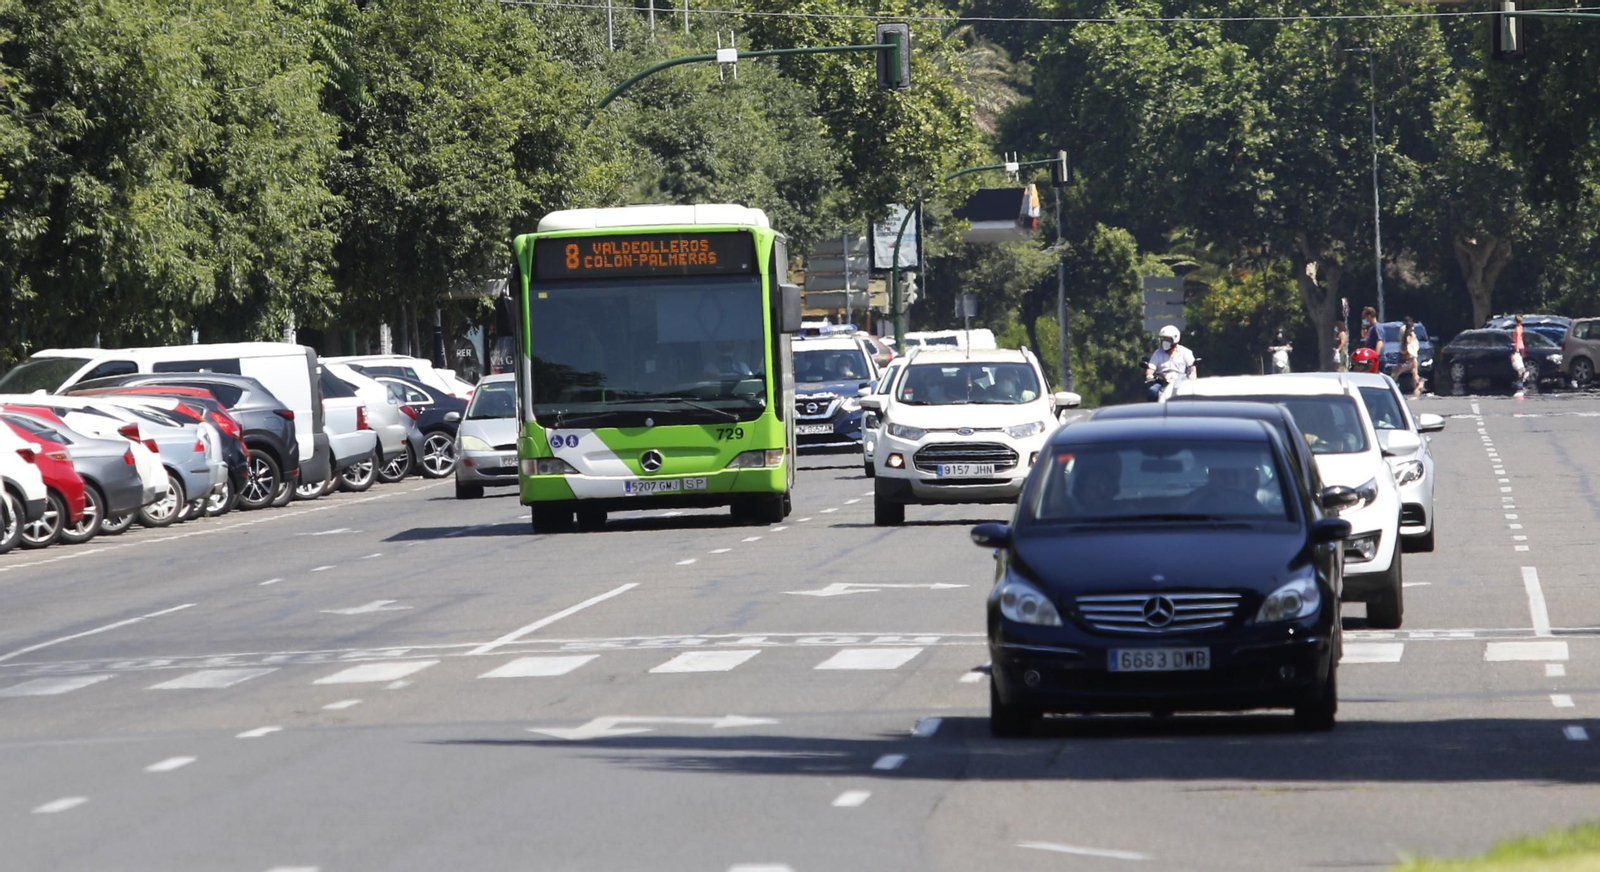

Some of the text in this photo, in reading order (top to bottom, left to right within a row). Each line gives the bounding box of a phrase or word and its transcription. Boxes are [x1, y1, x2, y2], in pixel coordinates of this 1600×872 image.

[592, 239, 710, 255] VALDEOLLEROS
[565, 243, 580, 269] 8
[584, 251, 717, 268] COLON-PALMERAS
[716, 428, 744, 439] 729
[944, 465, 993, 475] 9157 JHN
[631, 481, 679, 492] 5207 GMJ
[1121, 650, 1206, 669] 6683 DWB
